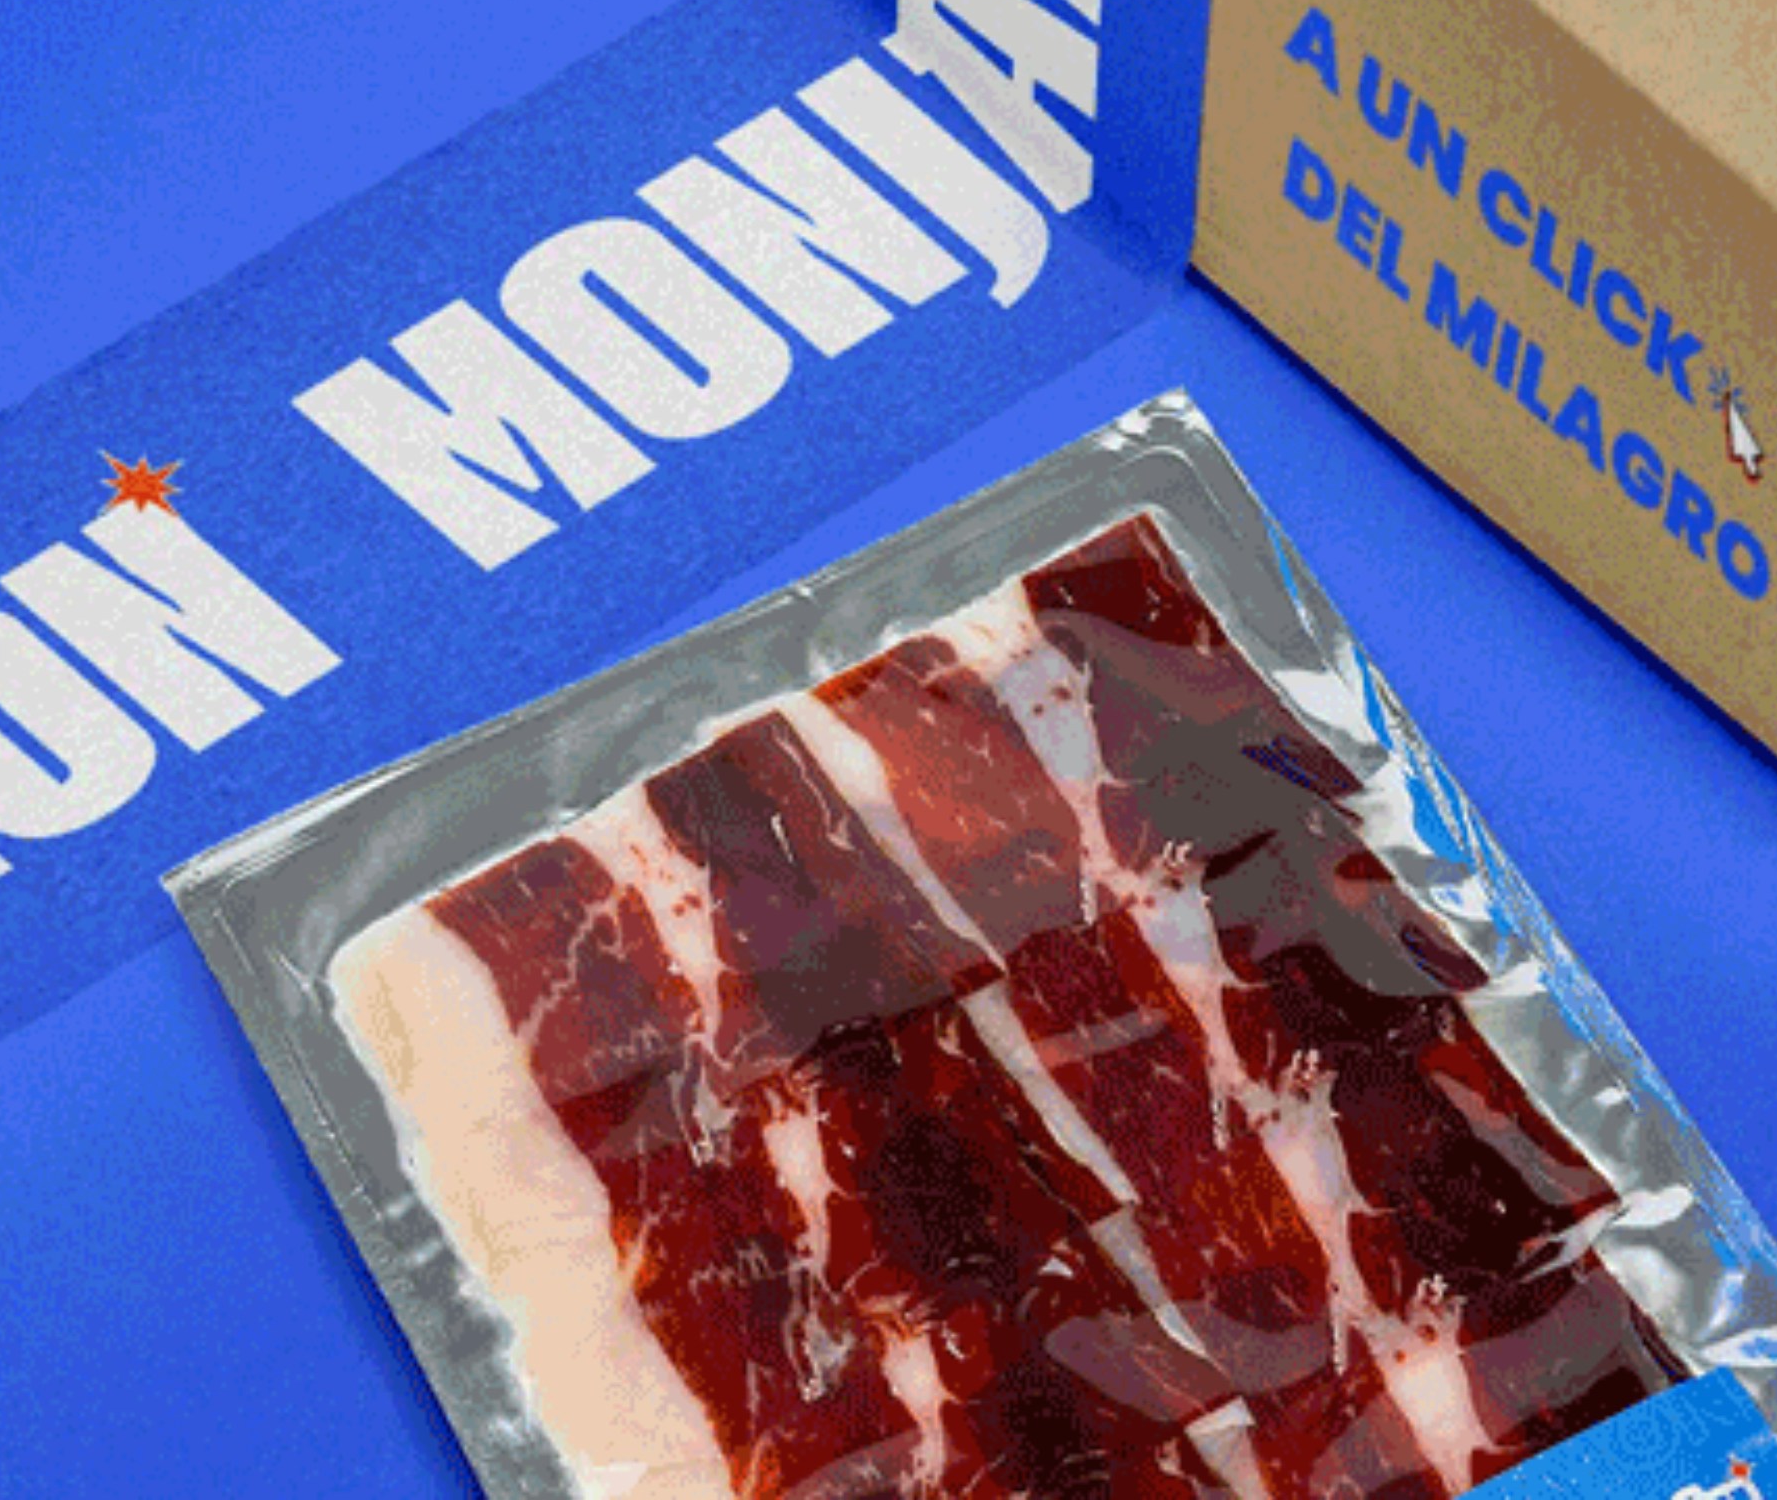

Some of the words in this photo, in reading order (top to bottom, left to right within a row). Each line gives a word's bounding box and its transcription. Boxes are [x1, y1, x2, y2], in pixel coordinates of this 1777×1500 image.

[1282, 137, 1411, 301] DEL
[1424, 260, 1771, 601] MILAGRO
[1283, 6, 1341, 95] A
[1357, 54, 1467, 199] UN
[1476, 168, 1704, 404] CLICK
